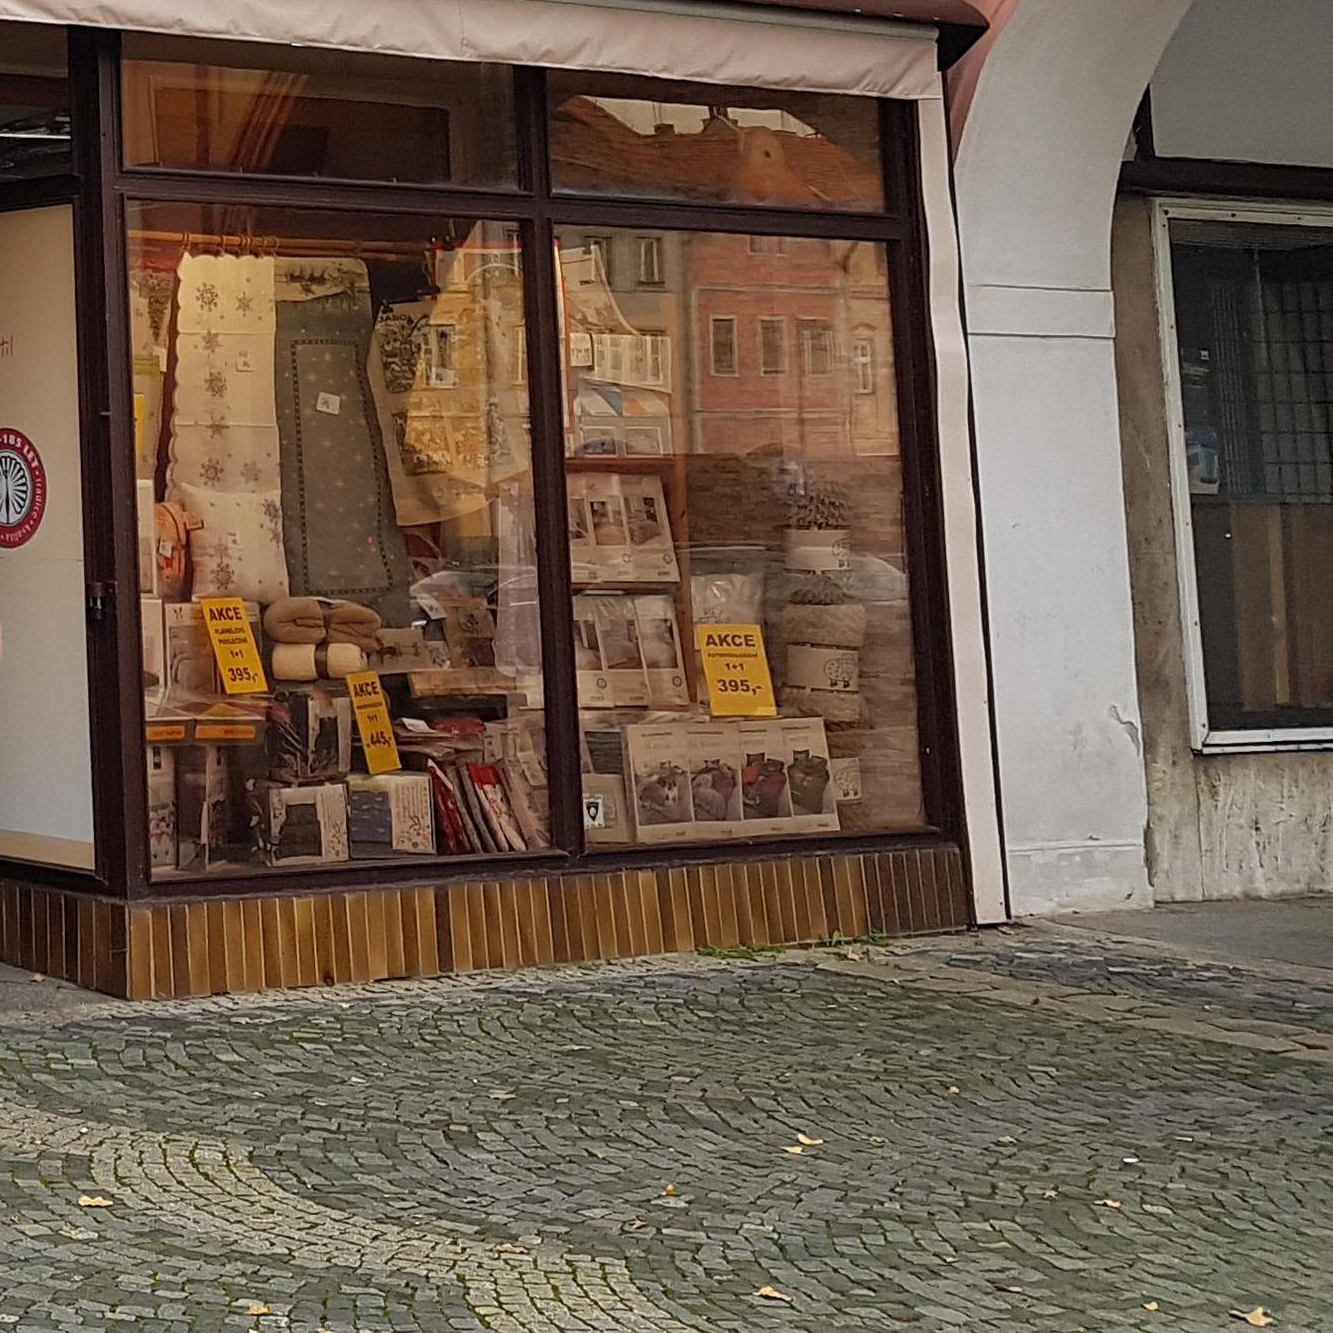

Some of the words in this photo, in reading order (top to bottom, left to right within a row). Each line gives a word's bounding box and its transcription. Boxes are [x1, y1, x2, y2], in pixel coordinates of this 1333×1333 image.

[23, 445, 40, 468] LET
[209, 607, 243, 621] AKCE
[706, 634, 756, 647] AKCE
[228, 667, 259, 683] 395,-
[353, 682, 379, 697] AKCE
[717, 679, 763, 695] 395,-
